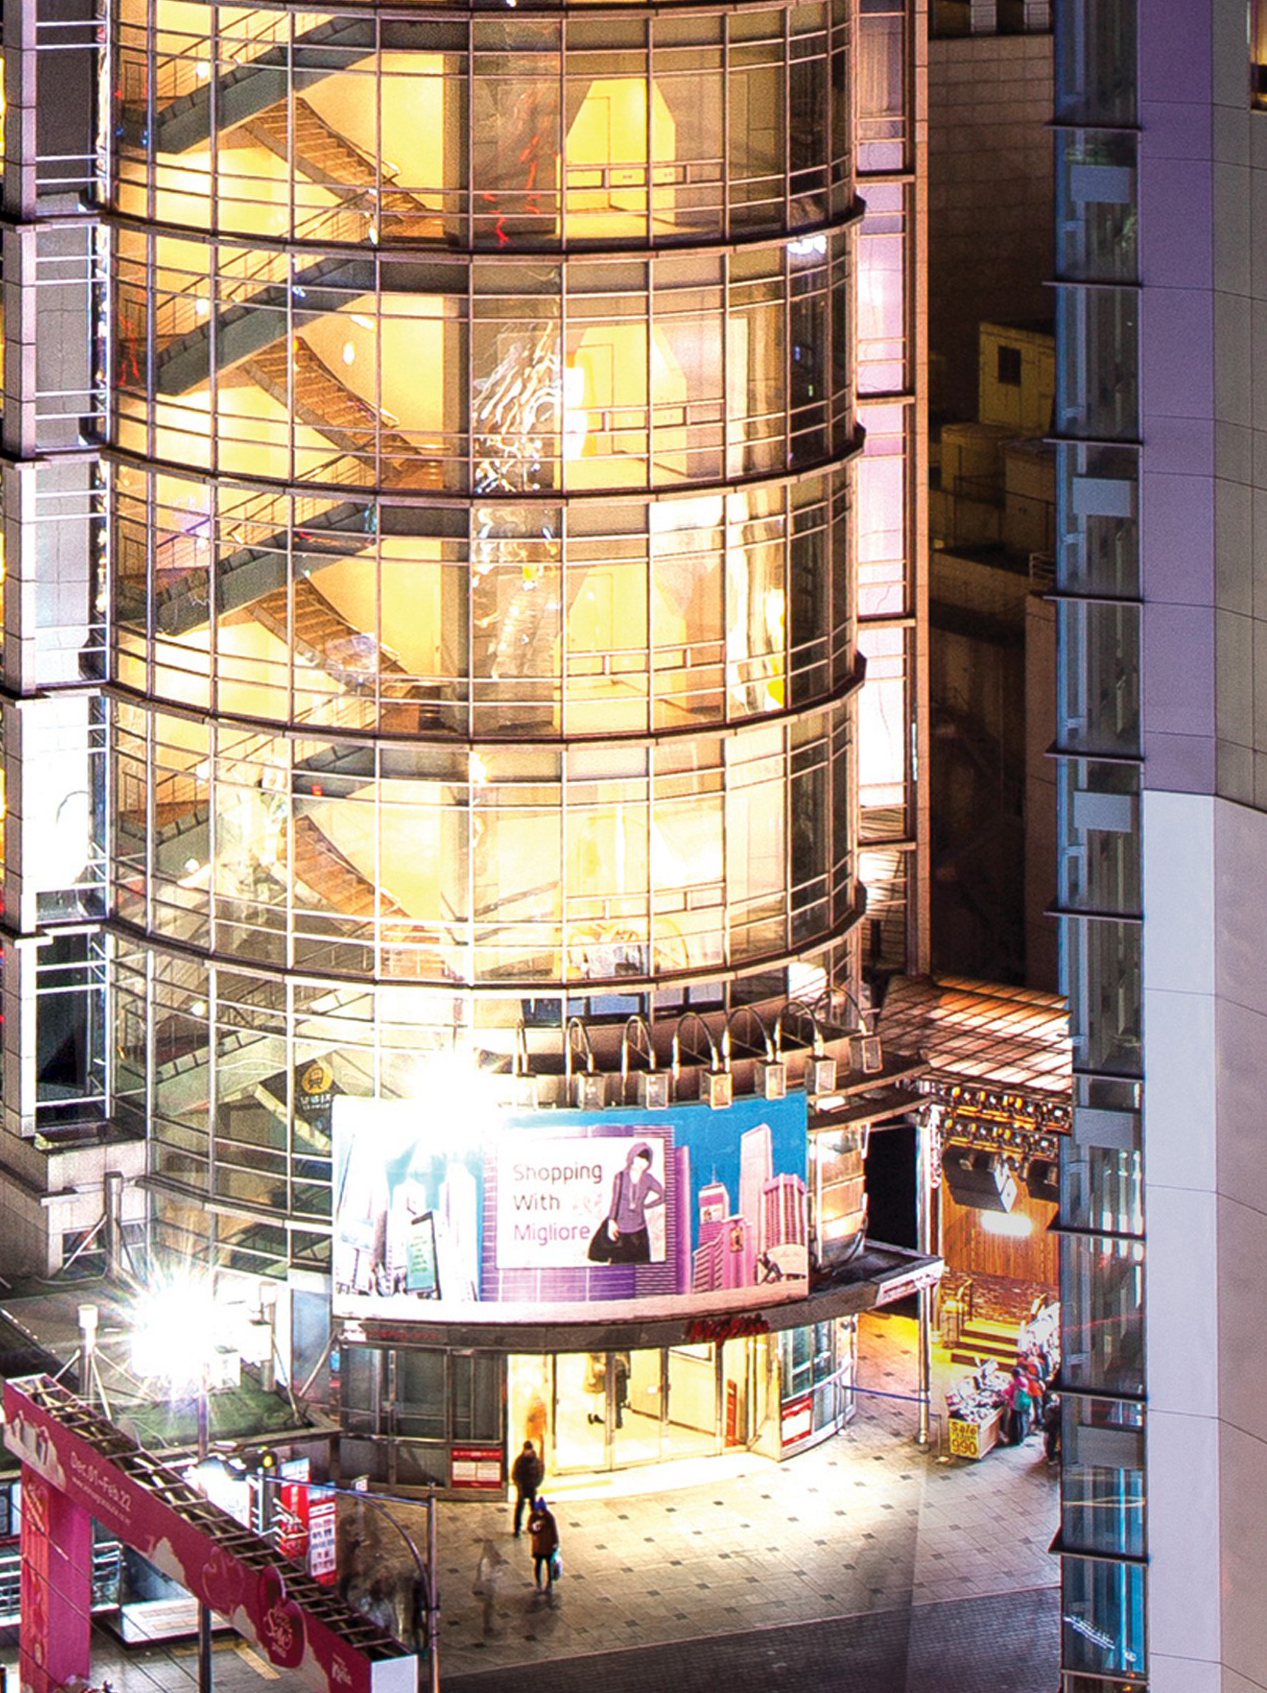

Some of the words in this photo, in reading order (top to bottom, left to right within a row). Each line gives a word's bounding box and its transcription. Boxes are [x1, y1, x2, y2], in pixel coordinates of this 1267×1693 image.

[513, 1163, 603, 1185] Shopping
[513, 1193, 561, 1211] With
[513, 1222, 591, 1246] Migliore
